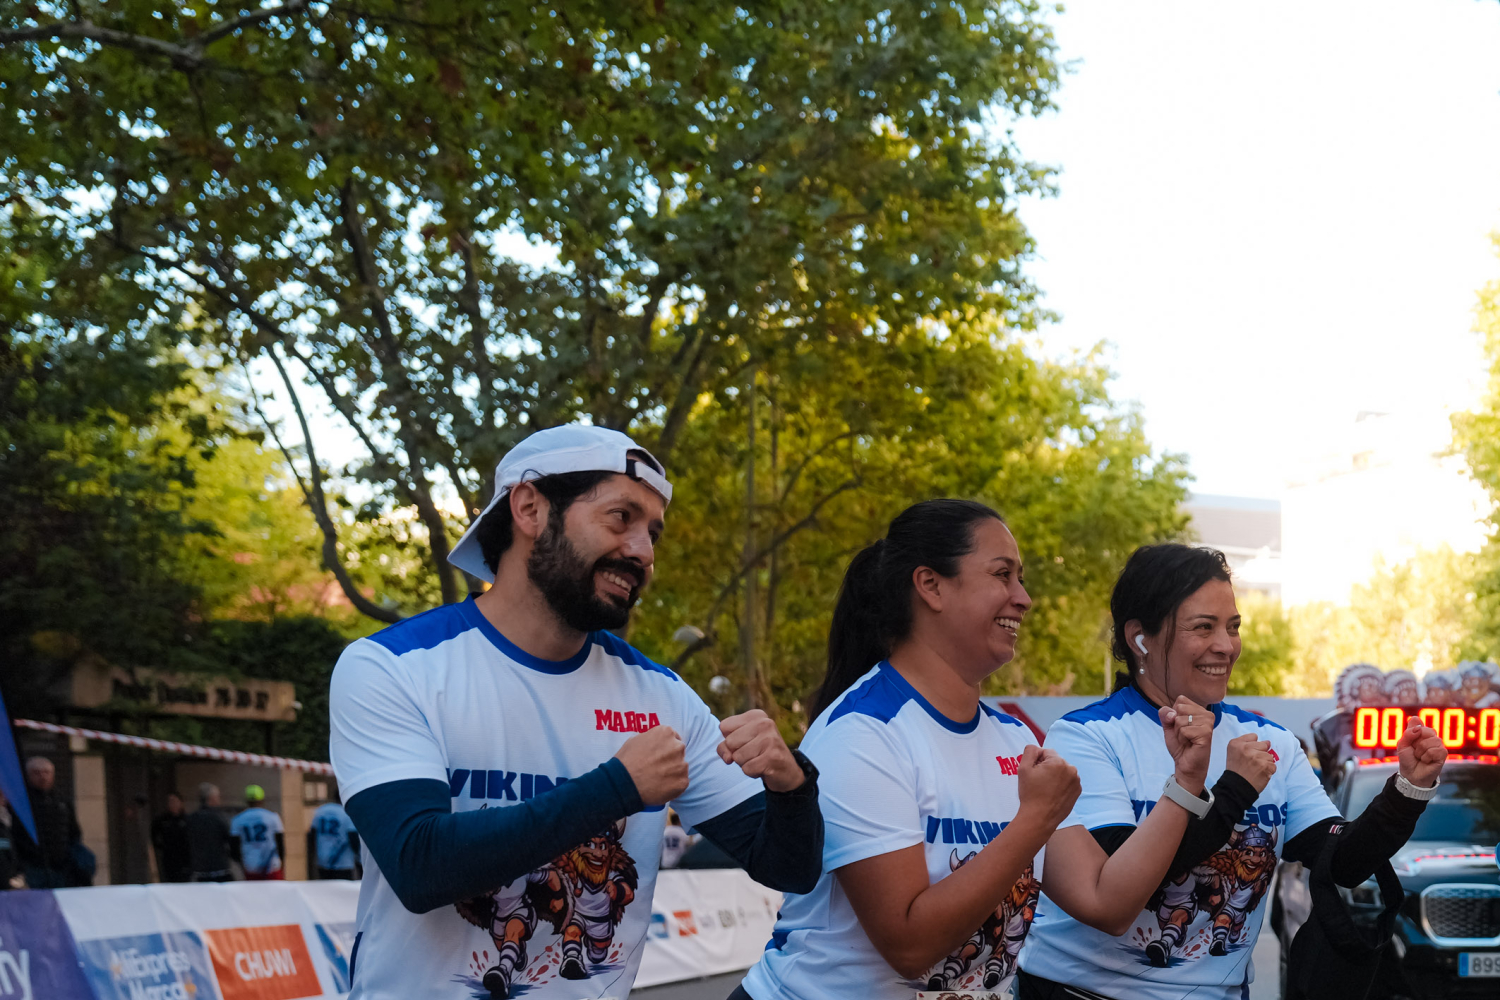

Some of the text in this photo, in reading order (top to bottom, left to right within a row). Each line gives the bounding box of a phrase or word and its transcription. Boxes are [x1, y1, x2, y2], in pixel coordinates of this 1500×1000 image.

[594, 709, 661, 733] MARCA
[996, 754, 1023, 776] MAR
[446, 768, 570, 801] VIKIN
[243, 823, 268, 842] 12
[926, 815, 1011, 844] VIKIN
[235, 949, 297, 981] CHUWI
